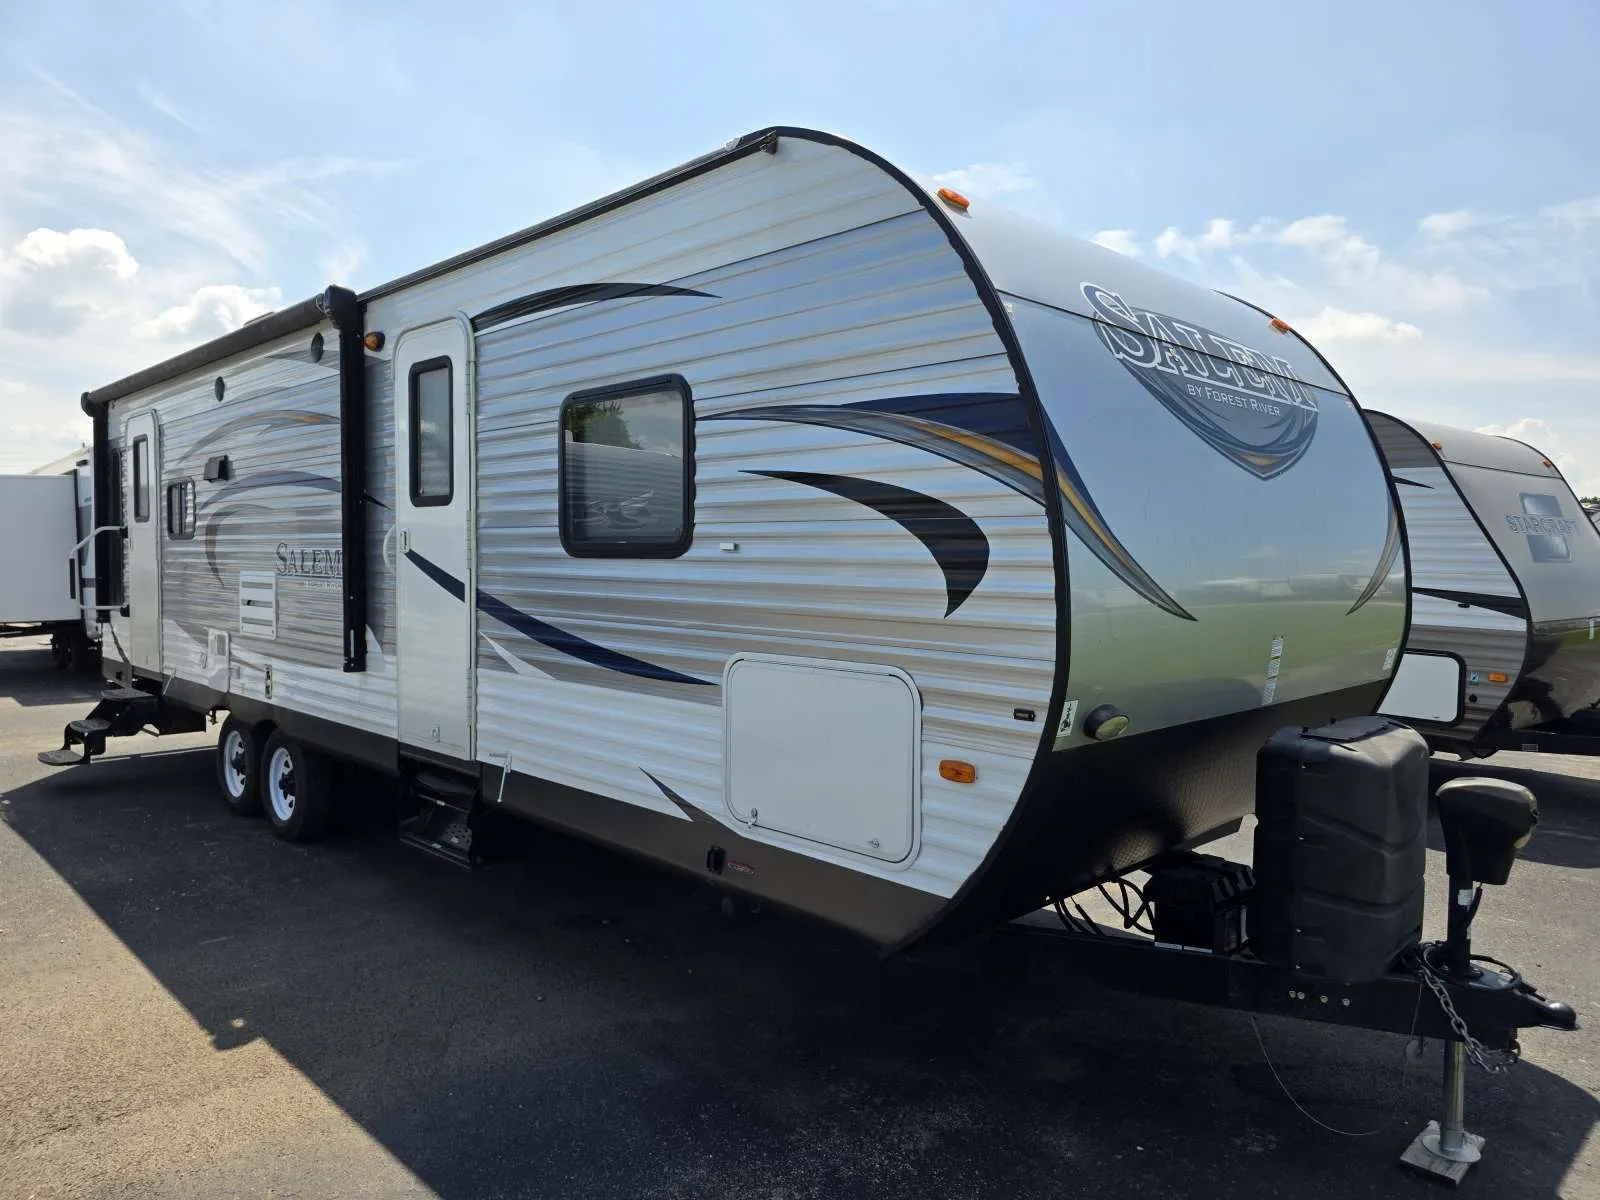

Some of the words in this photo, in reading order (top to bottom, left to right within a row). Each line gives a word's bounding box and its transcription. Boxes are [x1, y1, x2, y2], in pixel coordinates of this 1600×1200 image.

[1080, 281, 1319, 413] SALEM
[1187, 383, 1202, 397] BY
[1205, 386, 1248, 408] FOREST
[1250, 399, 1281, 416] RIVER
[276, 542, 343, 577] SALEM
